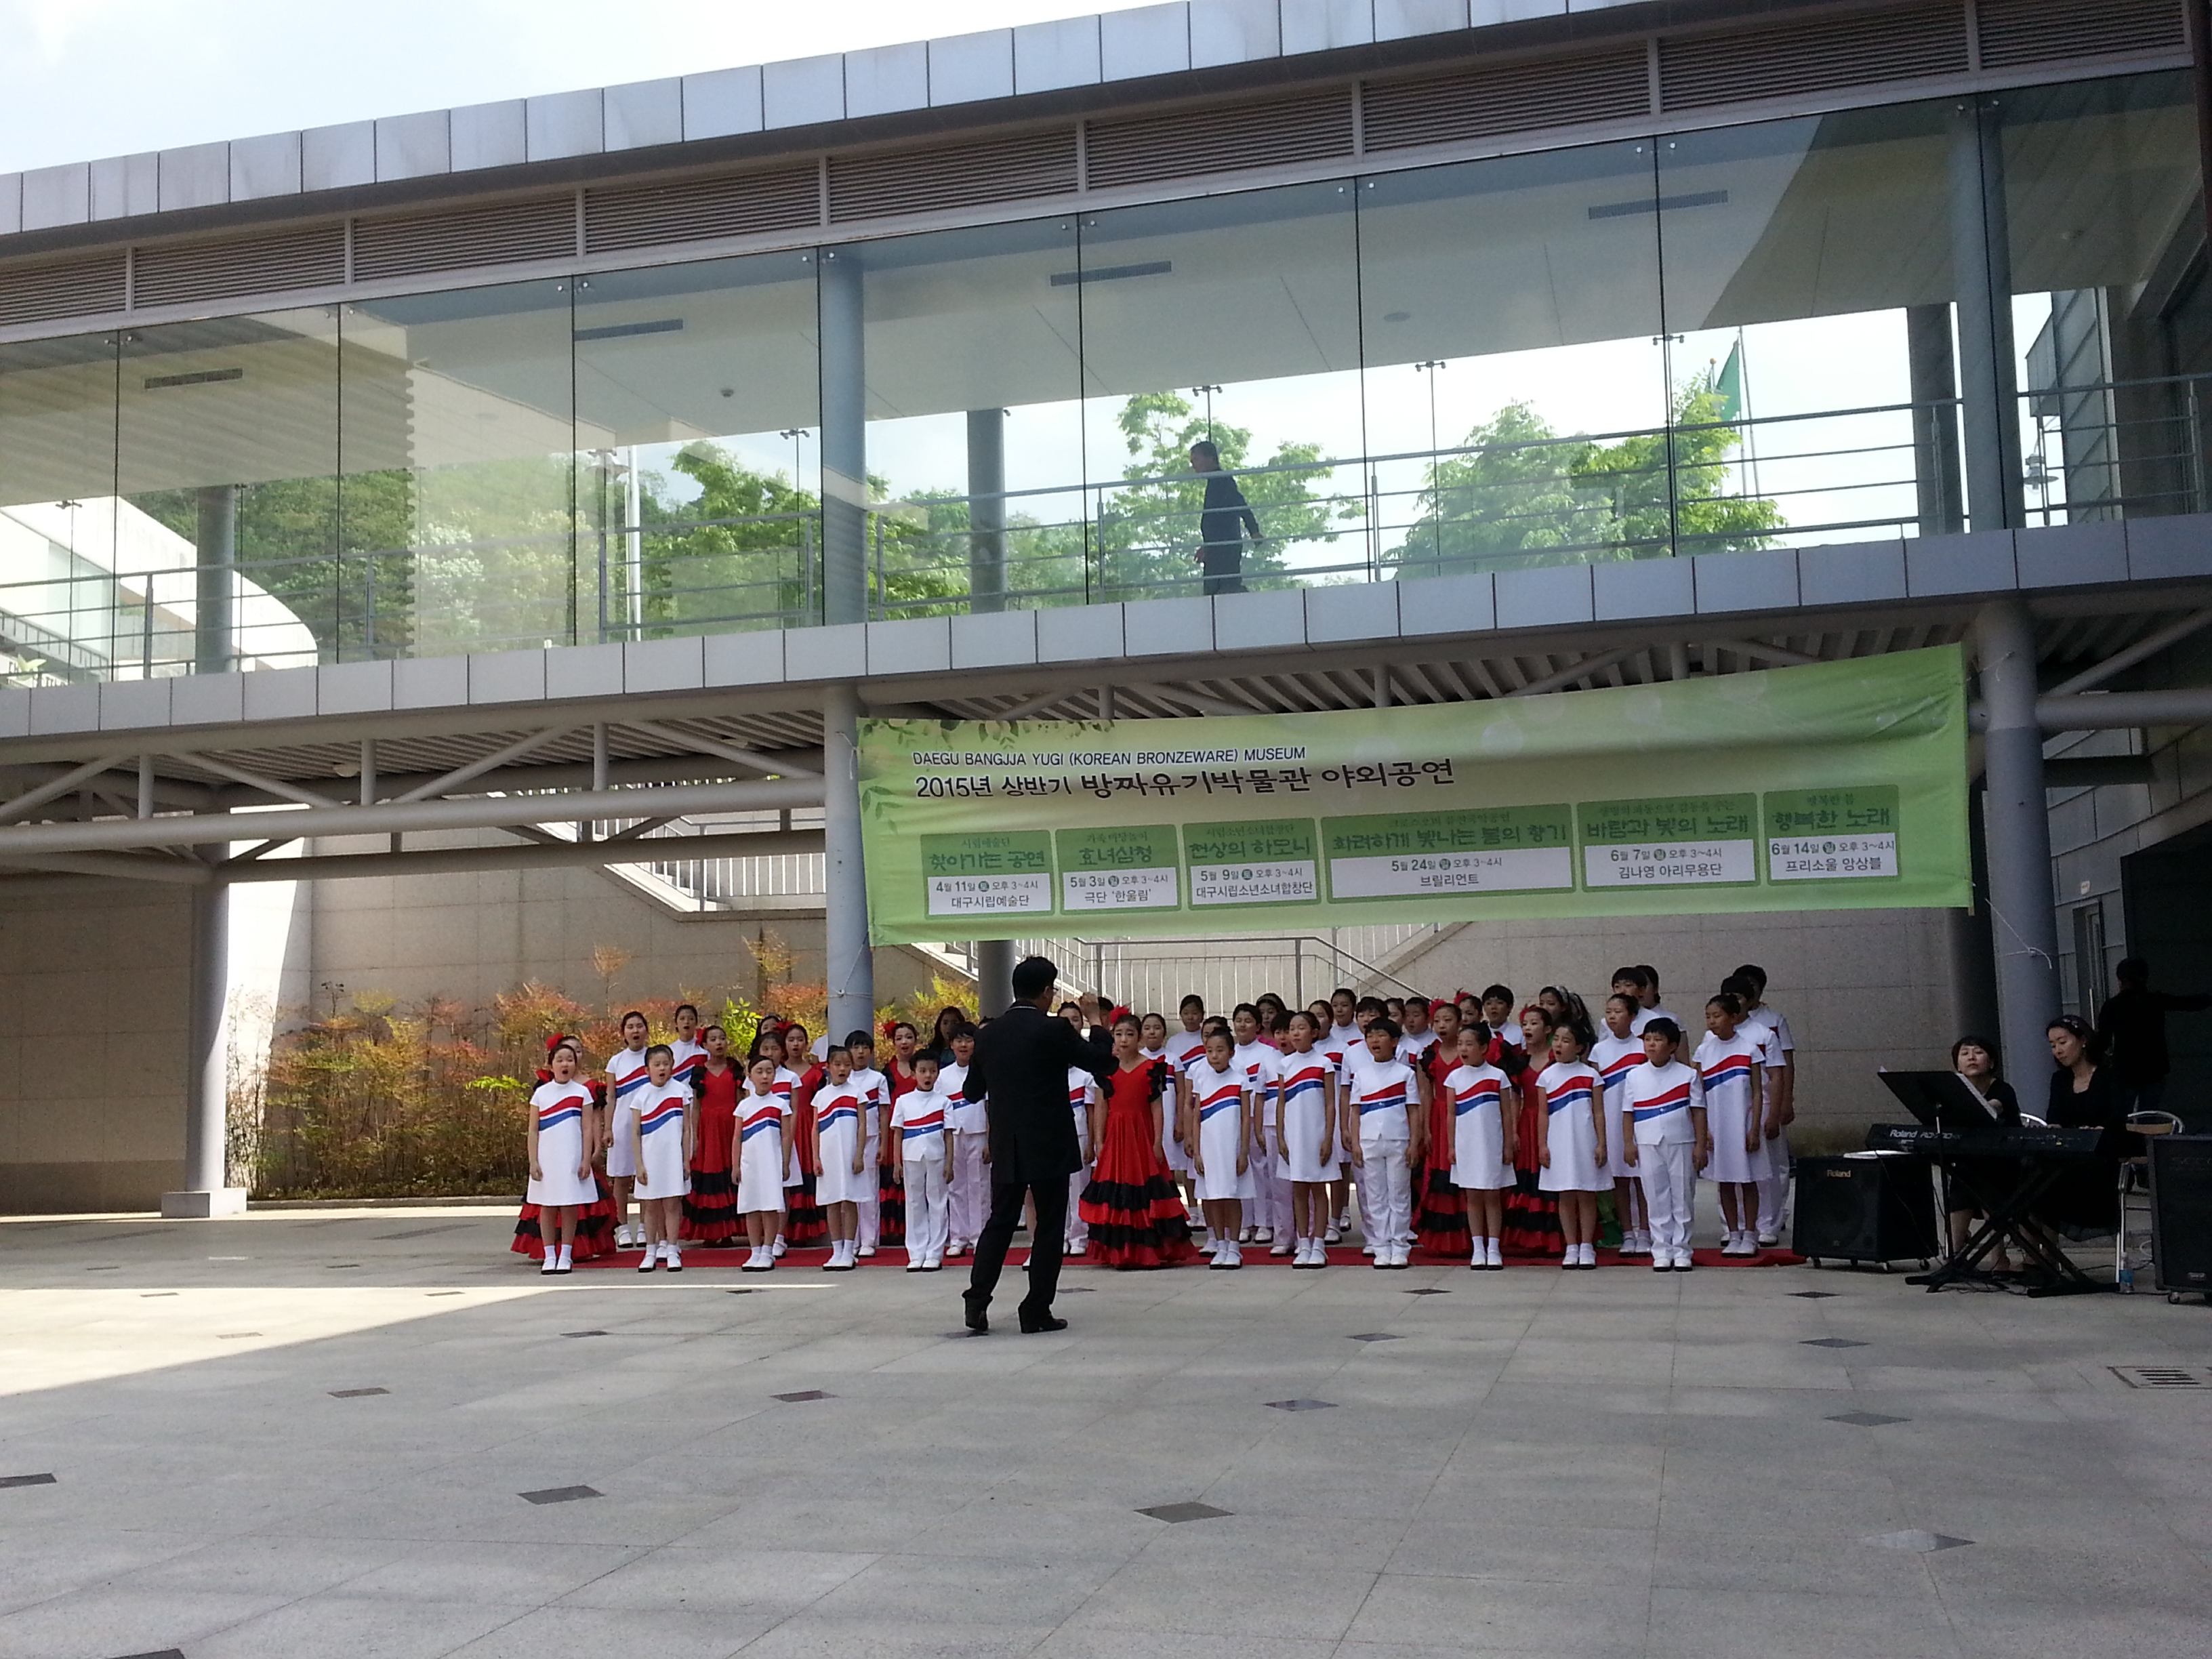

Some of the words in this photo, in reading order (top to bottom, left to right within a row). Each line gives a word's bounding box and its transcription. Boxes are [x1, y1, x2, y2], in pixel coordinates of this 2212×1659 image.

[913, 752, 959, 765] DAEGU
[965, 752, 1026, 765] BANGJJA
[1032, 753, 1063, 765] YUGI
[1069, 752, 1131, 766] (KOREAN
[1137, 749, 1237, 765] BRONZEWARE)
[1244, 746, 1305, 761] MUSEUM
[916, 775, 994, 798] 2015년
[1002, 775, 1072, 797] 상반기
[1081, 768, 1312, 798] 방짜유기박물관
[1322, 758, 1454, 789] 야외공연
[1587, 819, 1650, 838] 바람과
[1656, 817, 1696, 836] 빛의
[1706, 815, 1748, 834] 노래
[1772, 810, 1839, 831] 행복한
[1846, 808, 1889, 827] 노래
[1333, 832, 1410, 851] 화려하게
[1416, 829, 1477, 848] 빛나는
[1527, 823, 1566, 842] 향기
[1189, 840, 1246, 859] 천상의
[1251, 836, 1310, 855] 하모니
[1771, 843, 1790, 855] 6월
[1795, 842, 1820, 854] 14일
[1839, 842, 1858, 851] 오후
[929, 851, 1002, 872] 찾아가는
[1007, 850, 1045, 869] 공연
[1079, 845, 1152, 865] 효녀심청
[1611, 850, 1628, 861] 6월
[1633, 849, 1650, 861] 7일
[1669, 849, 1687, 859] 오후
[1391, 861, 1408, 872] 5월
[1412, 859, 1436, 870] 24일
[1454, 859, 1471, 867] 오후
[1619, 865, 1654, 879] 김나영
[1660, 863, 1722, 877] 아리무용단
[1786, 858, 1838, 872] 프리소울
[1843, 857, 1881, 870] 앙상블
[1070, 876, 1086, 888] 5월
[1089, 876, 1105, 887] 3일
[1122, 876, 1139, 885] 오후
[1200, 870, 1216, 881] 5월
[1223, 869, 1239, 880] 9일
[1256, 869, 1273, 878] 오후
[1420, 874, 1479, 886] 브릴리언트
[936, 881, 951, 893] 4월
[955, 881, 975, 892] 11일
[992, 881, 1010, 890] 오후
[1197, 881, 1313, 898] 대구시립소년소녀합창단
[951, 895, 1029, 908] 대구시립예술단
[1085, 890, 1107, 903] 극단
[1890, 1129, 1918, 1138] Roland
[1826, 1169, 1851, 1179] Roland
